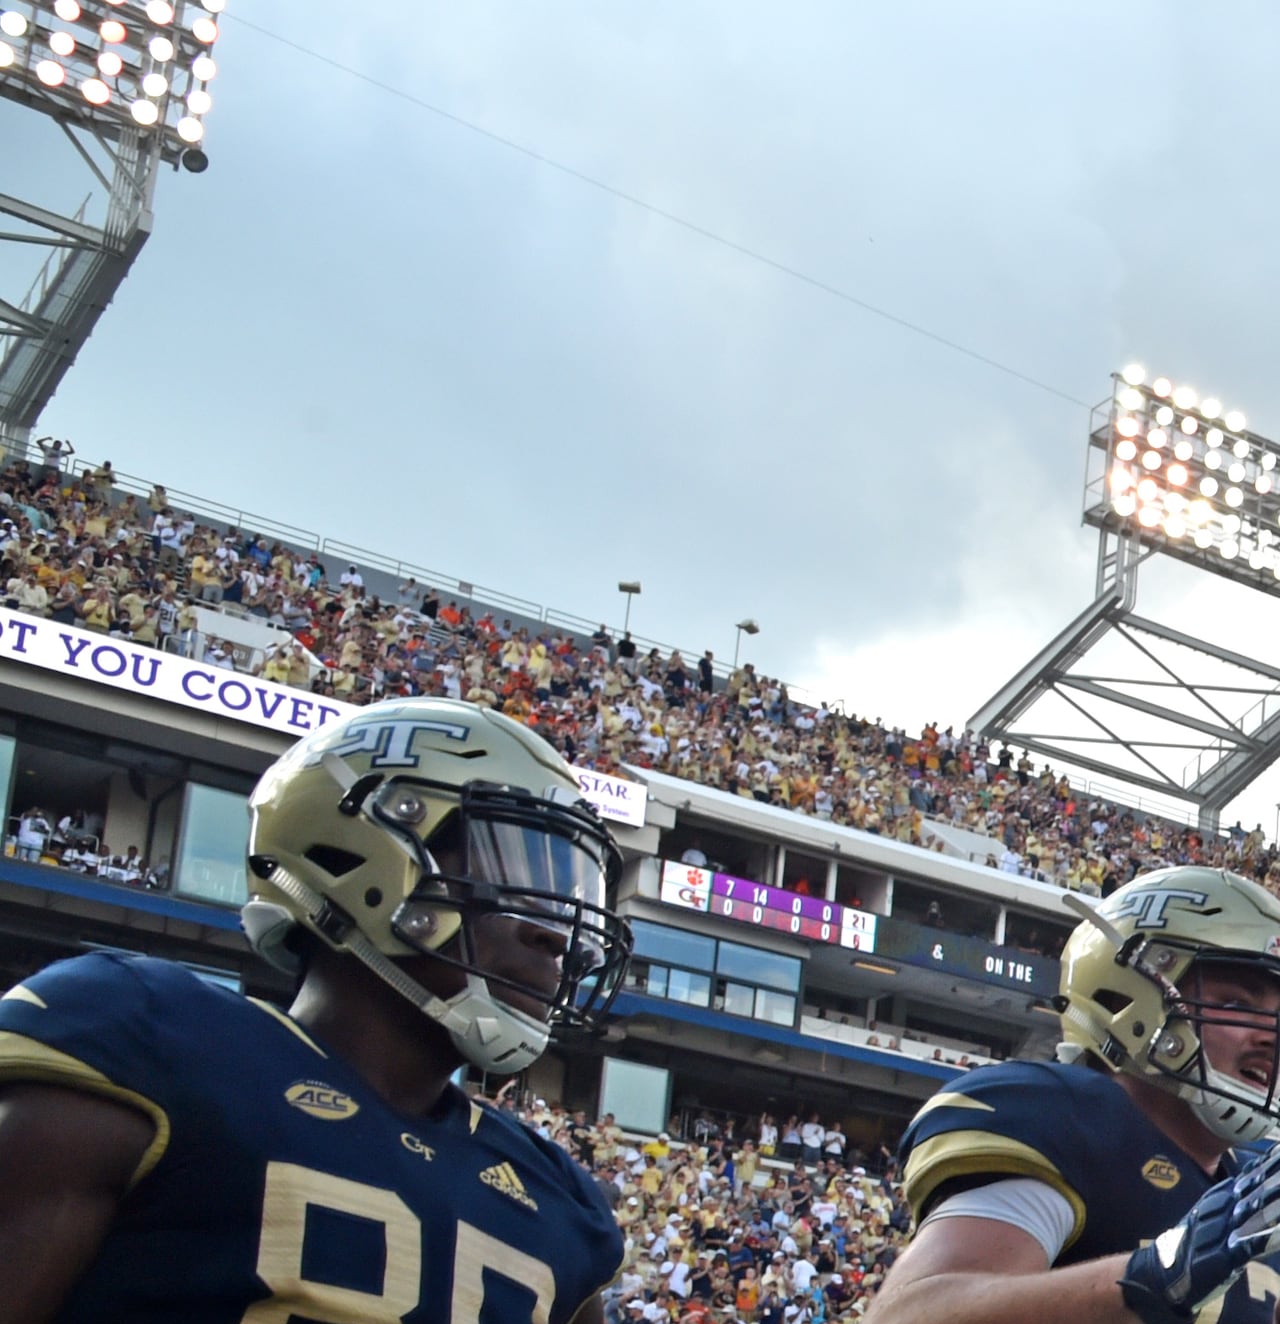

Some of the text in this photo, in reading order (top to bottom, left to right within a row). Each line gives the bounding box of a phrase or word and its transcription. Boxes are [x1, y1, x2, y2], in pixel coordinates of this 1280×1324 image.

[0, 619, 37, 653] T
[59, 633, 162, 686] YOU
[723, 899, 733, 916] 0
[753, 907, 762, 923] 0
[791, 917, 800, 933] 0
[821, 924, 830, 940] 0
[726, 880, 866, 930] 7 14 0 0 21
[932, 944, 1033, 983] & ON THE
[294, 1089, 352, 1113] ACC
[1146, 1162, 1175, 1181] ACC
